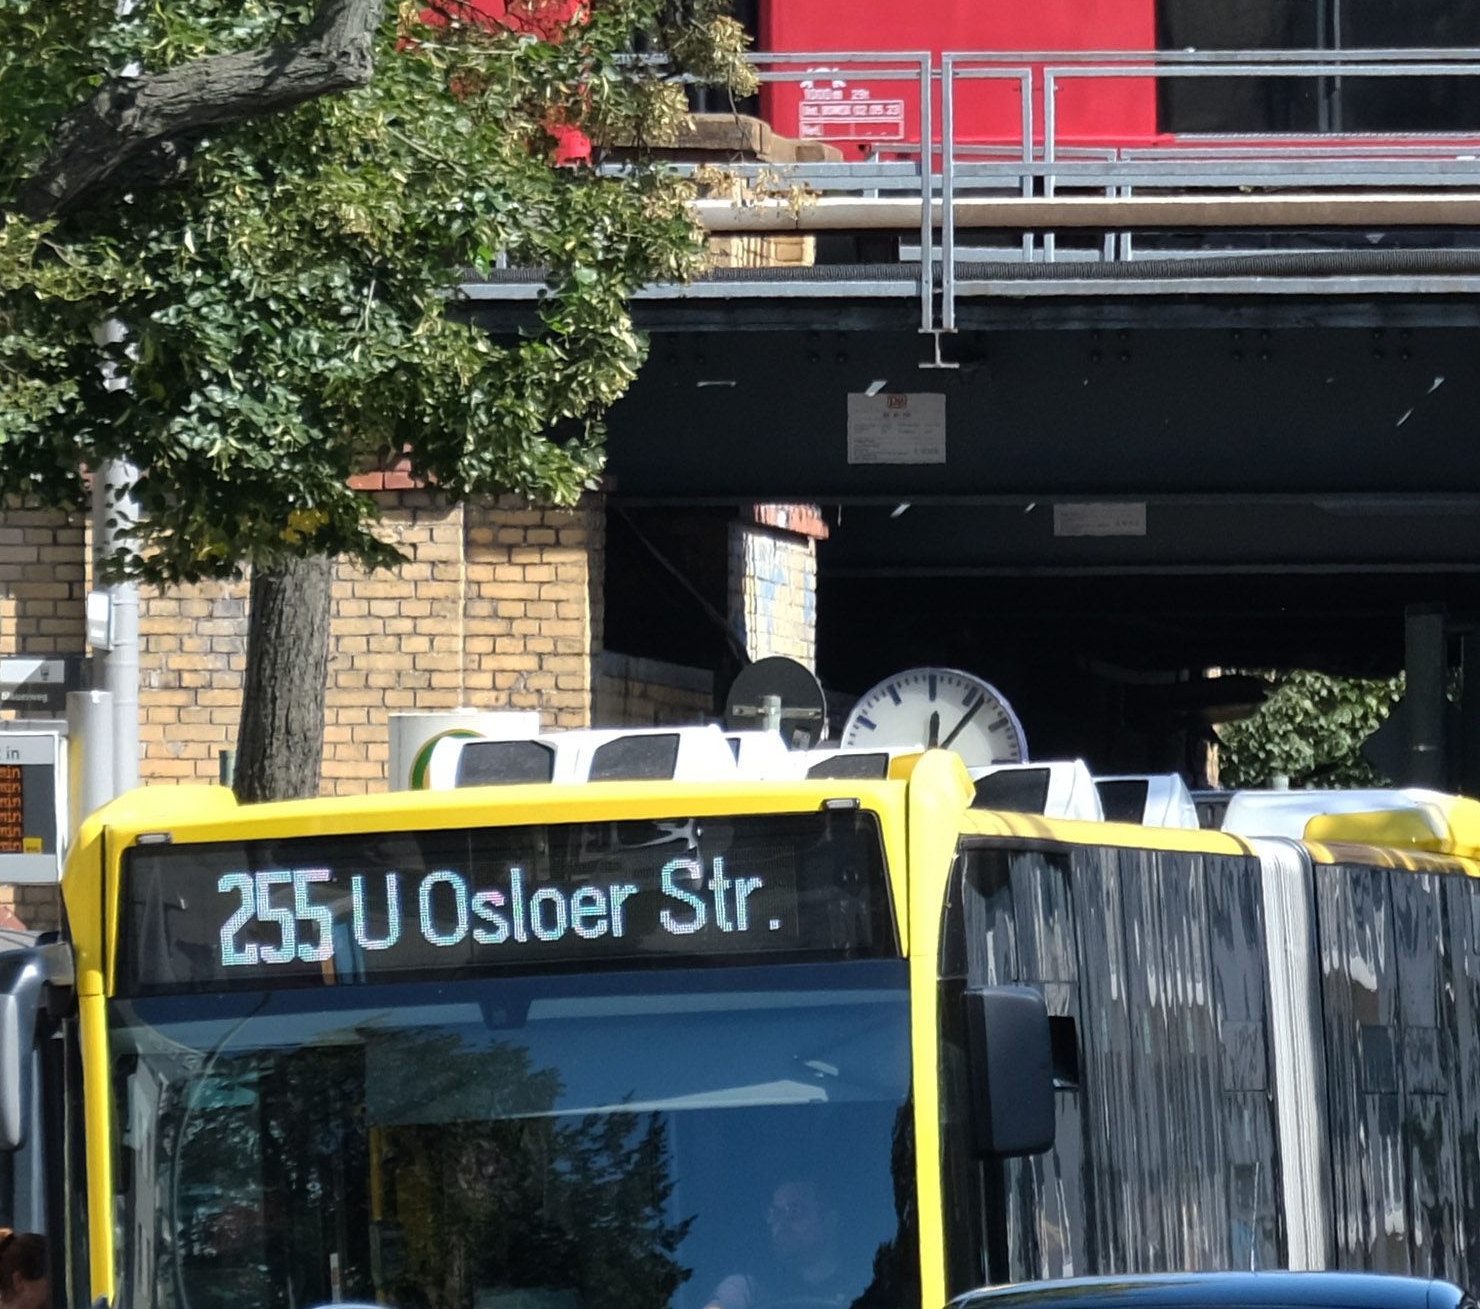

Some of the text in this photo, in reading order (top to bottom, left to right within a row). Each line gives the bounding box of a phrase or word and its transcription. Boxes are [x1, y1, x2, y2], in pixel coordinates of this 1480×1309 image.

[6, 746, 20, 760] in
[217, 856, 780, 968] 255 U Osloer Str.
